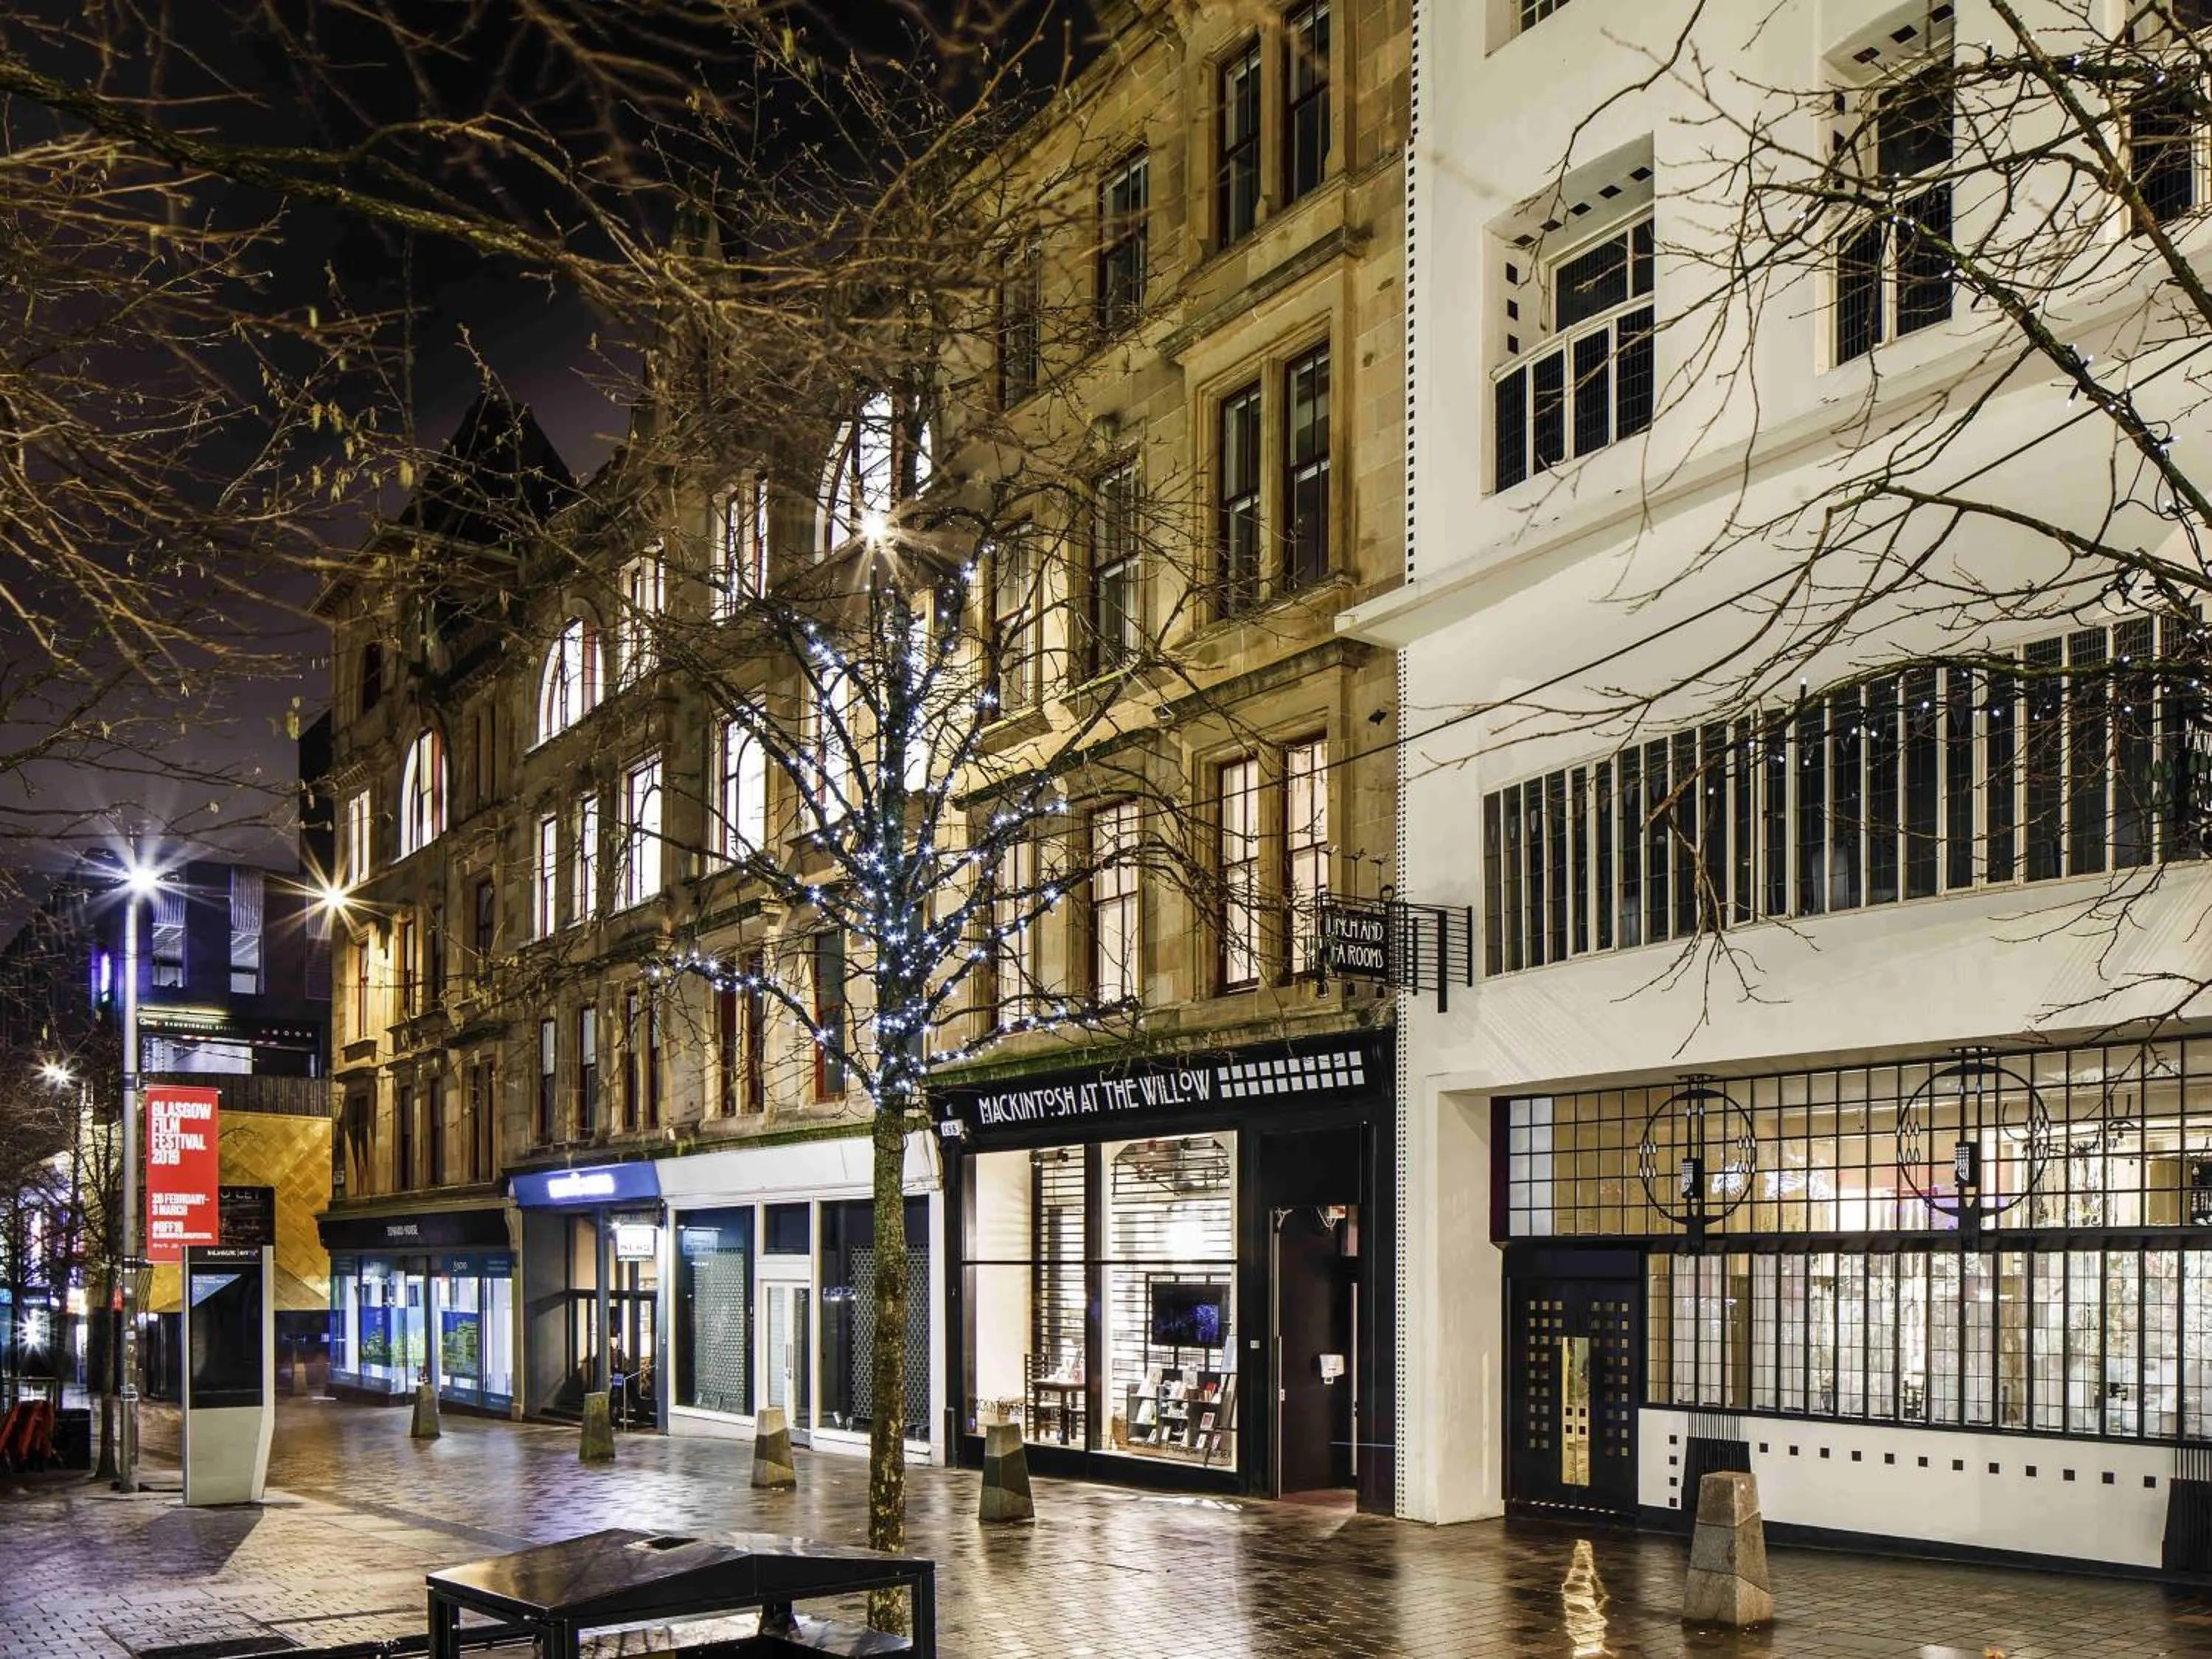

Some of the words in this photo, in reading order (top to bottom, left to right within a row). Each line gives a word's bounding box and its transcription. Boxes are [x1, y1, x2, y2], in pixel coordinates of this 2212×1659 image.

[1360, 919, 1384, 942] AND
[1347, 945, 1384, 968] ROOMS
[978, 1086, 1078, 1124] MACKINTOSH
[1081, 1082, 1099, 1114] AT
[1101, 1077, 1139, 1110] THE
[1139, 1068, 1210, 1106] WILLOW
[151, 1100, 212, 1120] GLASGOW
[151, 1116, 181, 1133] FILM
[151, 1133, 207, 1150] FESTIVAL
[151, 1149, 181, 1165] 2019
[159, 1204, 188, 1216] MARCH
